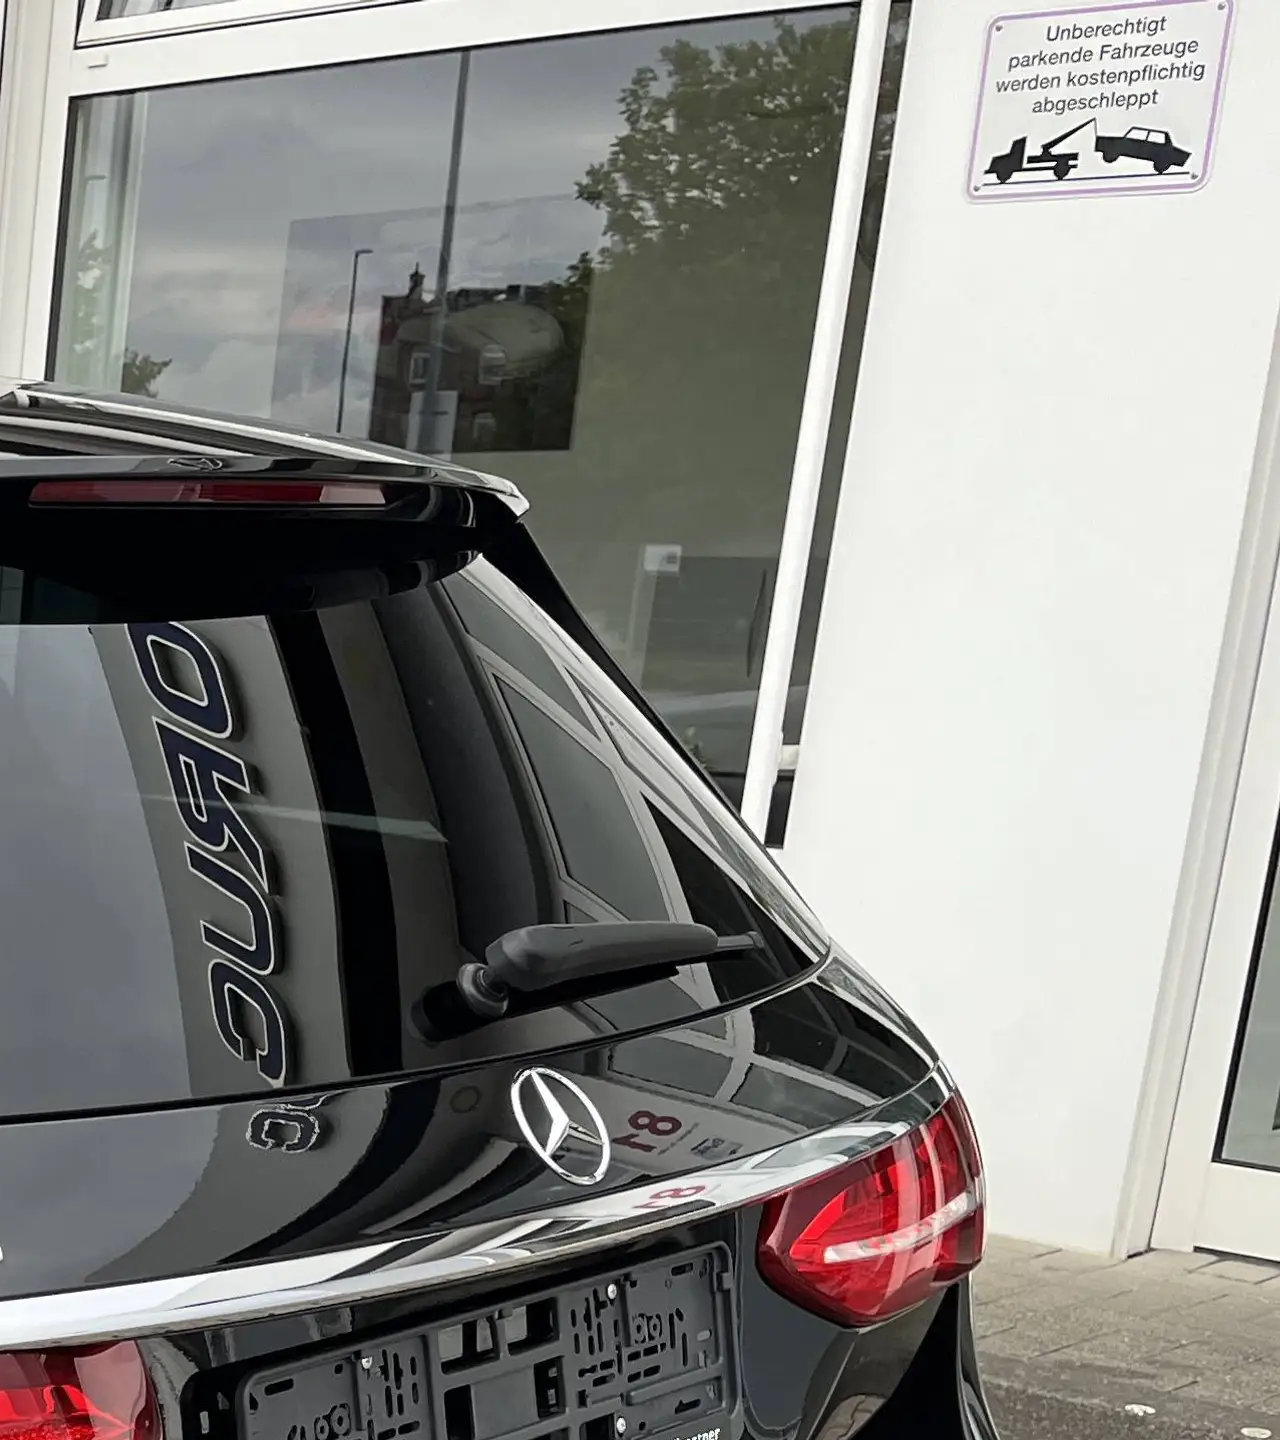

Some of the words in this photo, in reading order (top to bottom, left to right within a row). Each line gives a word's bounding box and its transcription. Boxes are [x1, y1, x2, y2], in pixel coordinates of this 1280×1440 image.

[1046, 16, 1167, 42] Unberechtigt
[1007, 46, 1093, 72] parkende
[1099, 40, 1199, 62] Fahrzeuge
[996, 74, 1060, 93] werden
[1066, 61, 1206, 87] kostenpflichtig
[1032, 90, 1158, 116] abgeschleppt
